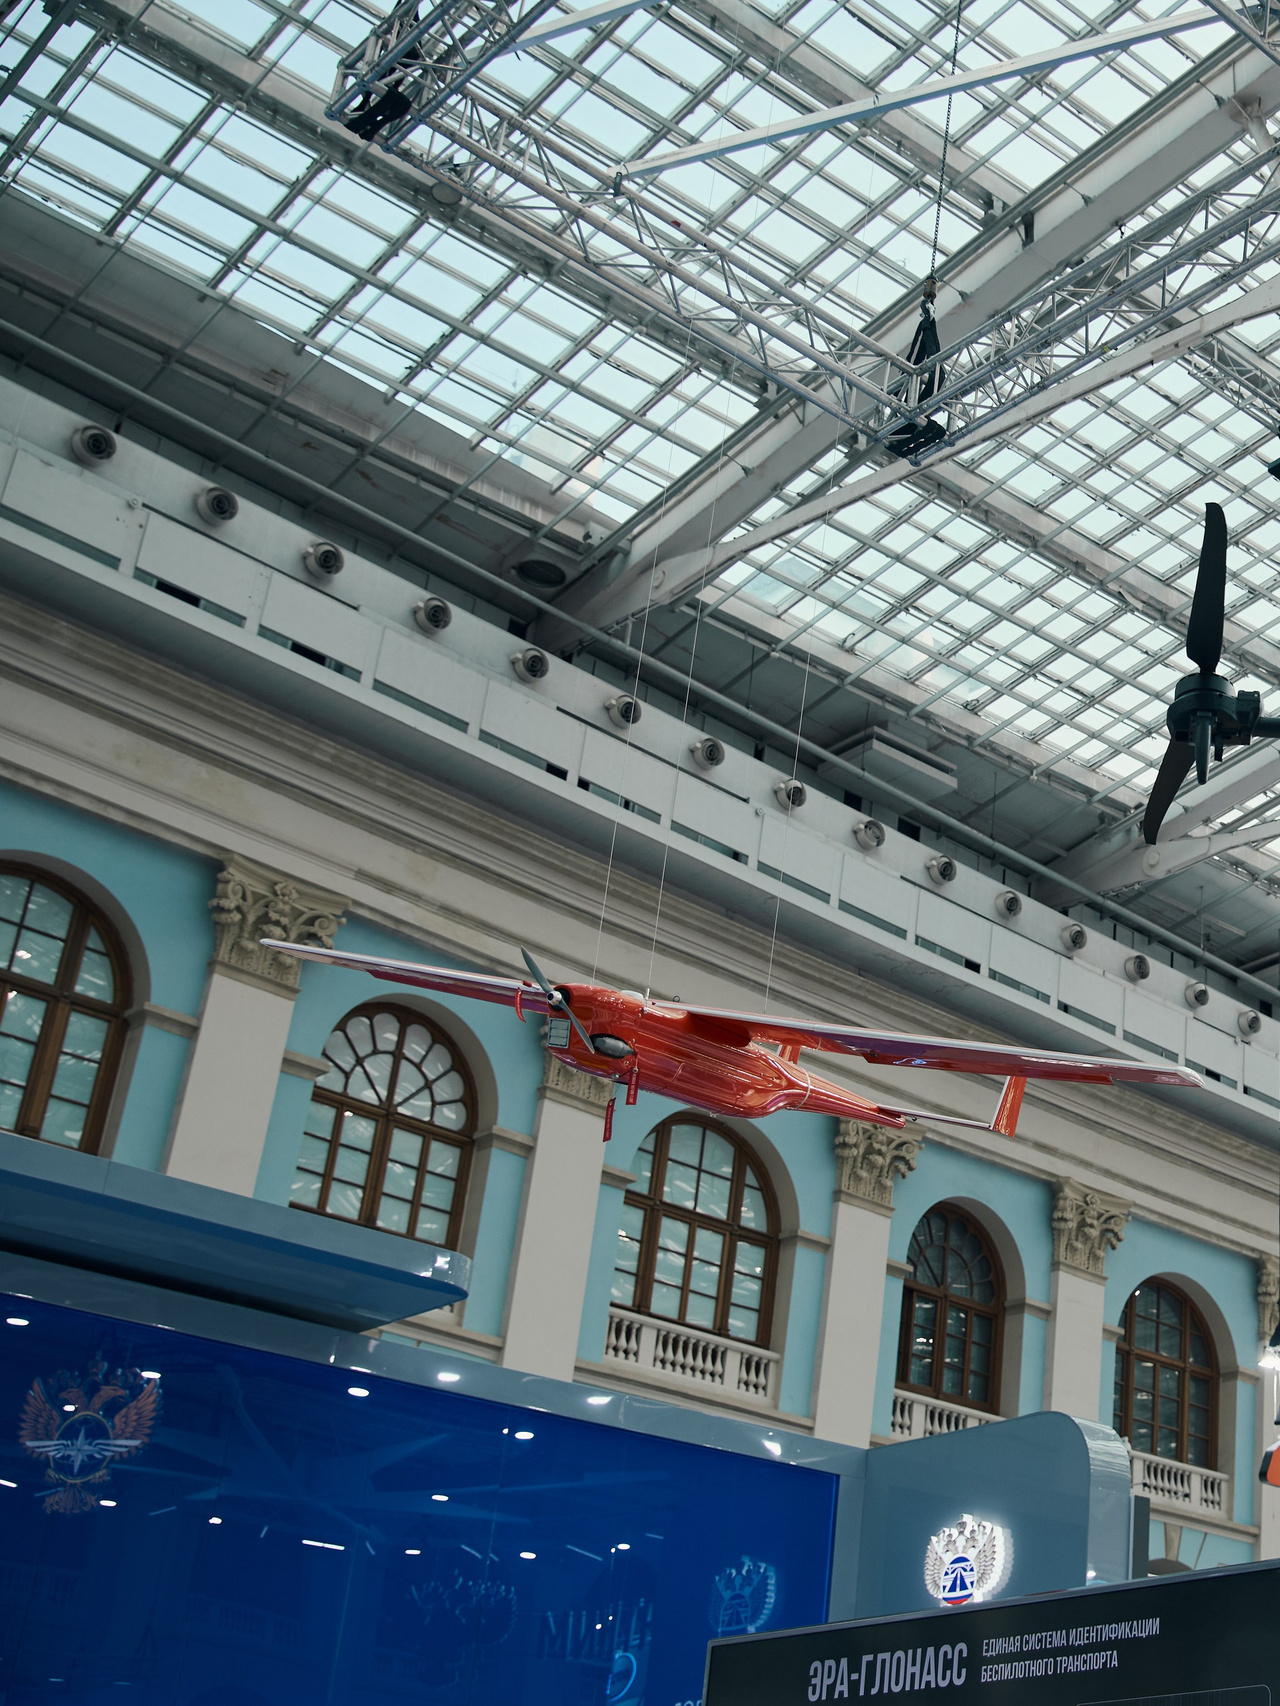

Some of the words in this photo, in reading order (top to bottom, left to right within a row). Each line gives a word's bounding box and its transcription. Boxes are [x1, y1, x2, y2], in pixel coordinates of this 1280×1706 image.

[982, 1635, 1021, 1657] ЕДИНАЯ
[1022, 1629, 1067, 1651] СИСТЕМА
[1069, 1617, 1161, 1646] ИДЕНТИФИКАЦИИ
[807, 1642, 968, 1702] ЭРА-ГЛОНАСС
[981, 1657, 1054, 1683] БЕСПИЛОТНОГО
[1056, 1650, 1119, 1674] ТРАНСПОРТА
